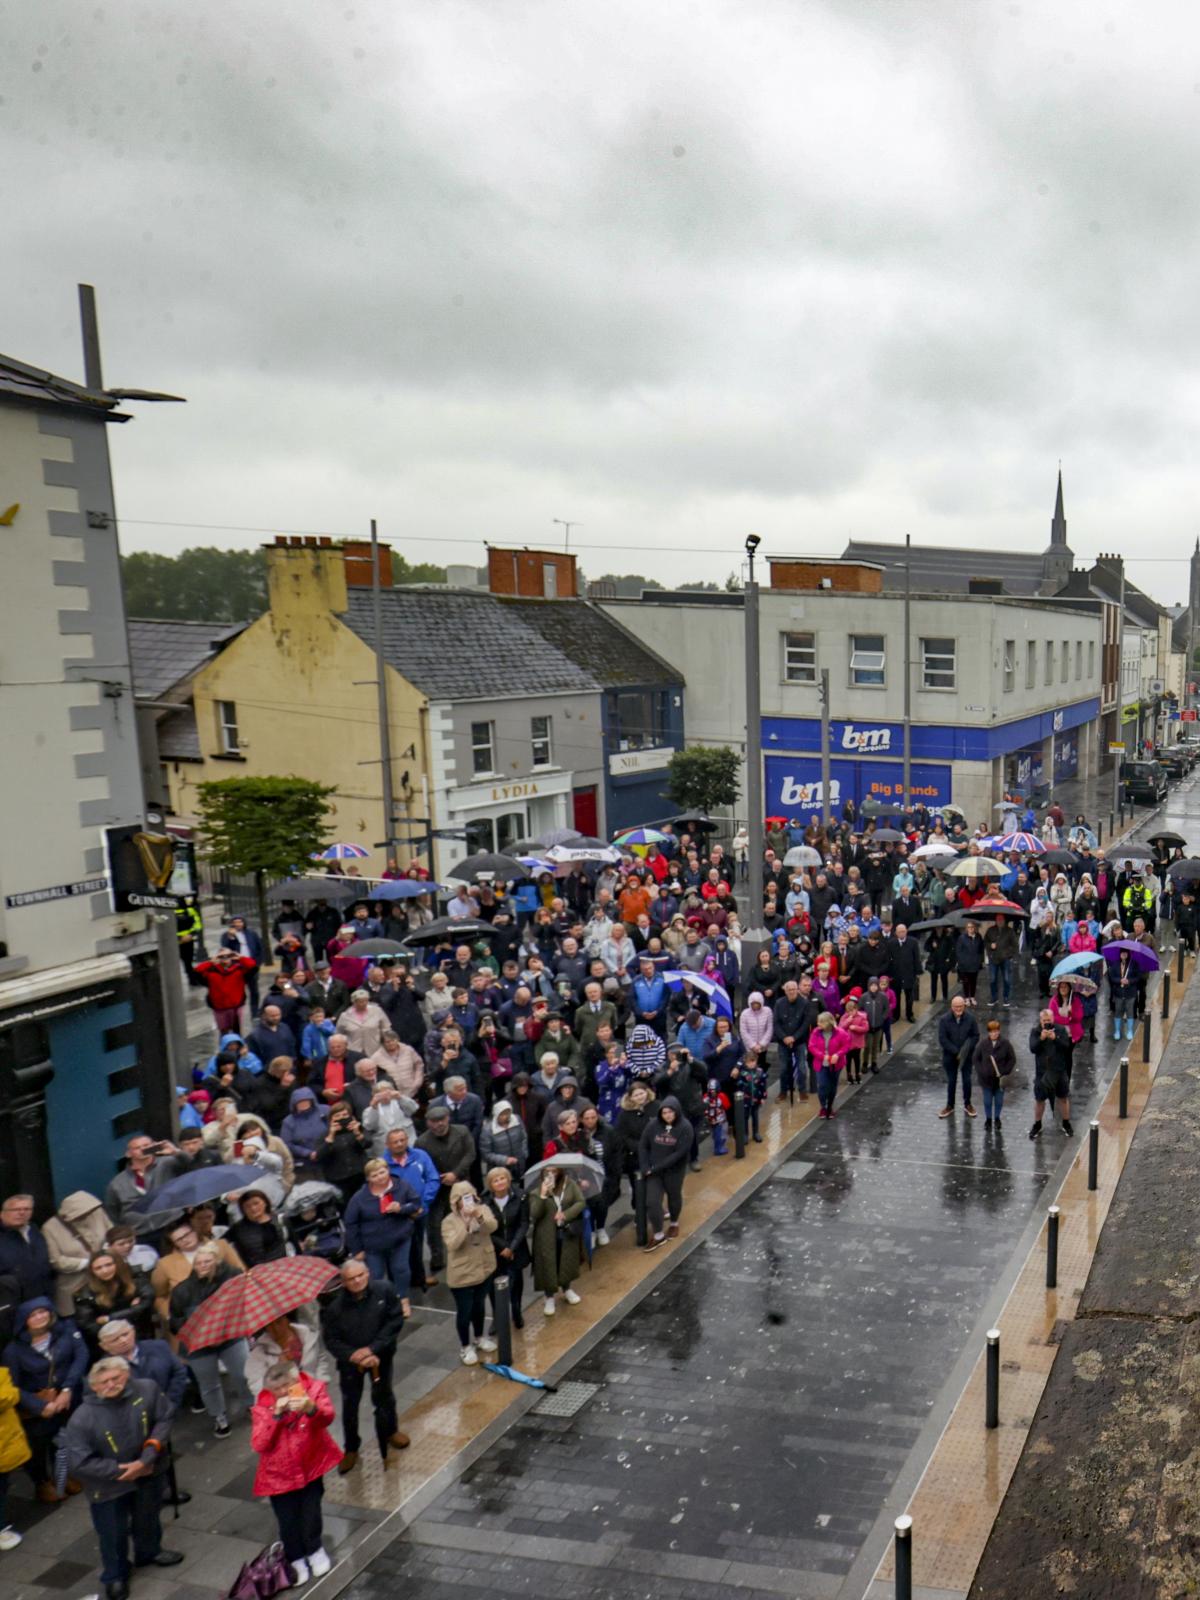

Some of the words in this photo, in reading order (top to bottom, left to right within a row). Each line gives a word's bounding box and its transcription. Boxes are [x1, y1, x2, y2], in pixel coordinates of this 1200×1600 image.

[492, 783, 539, 801] LYDIA
[871, 783, 892, 796] Big
[895, 784, 938, 797] Bands
[801, 799, 840, 809] bargns
[571, 850, 602, 861] PING
[10, 886, 68, 906] TOWNHALL
[71, 880, 107, 895] STREET
